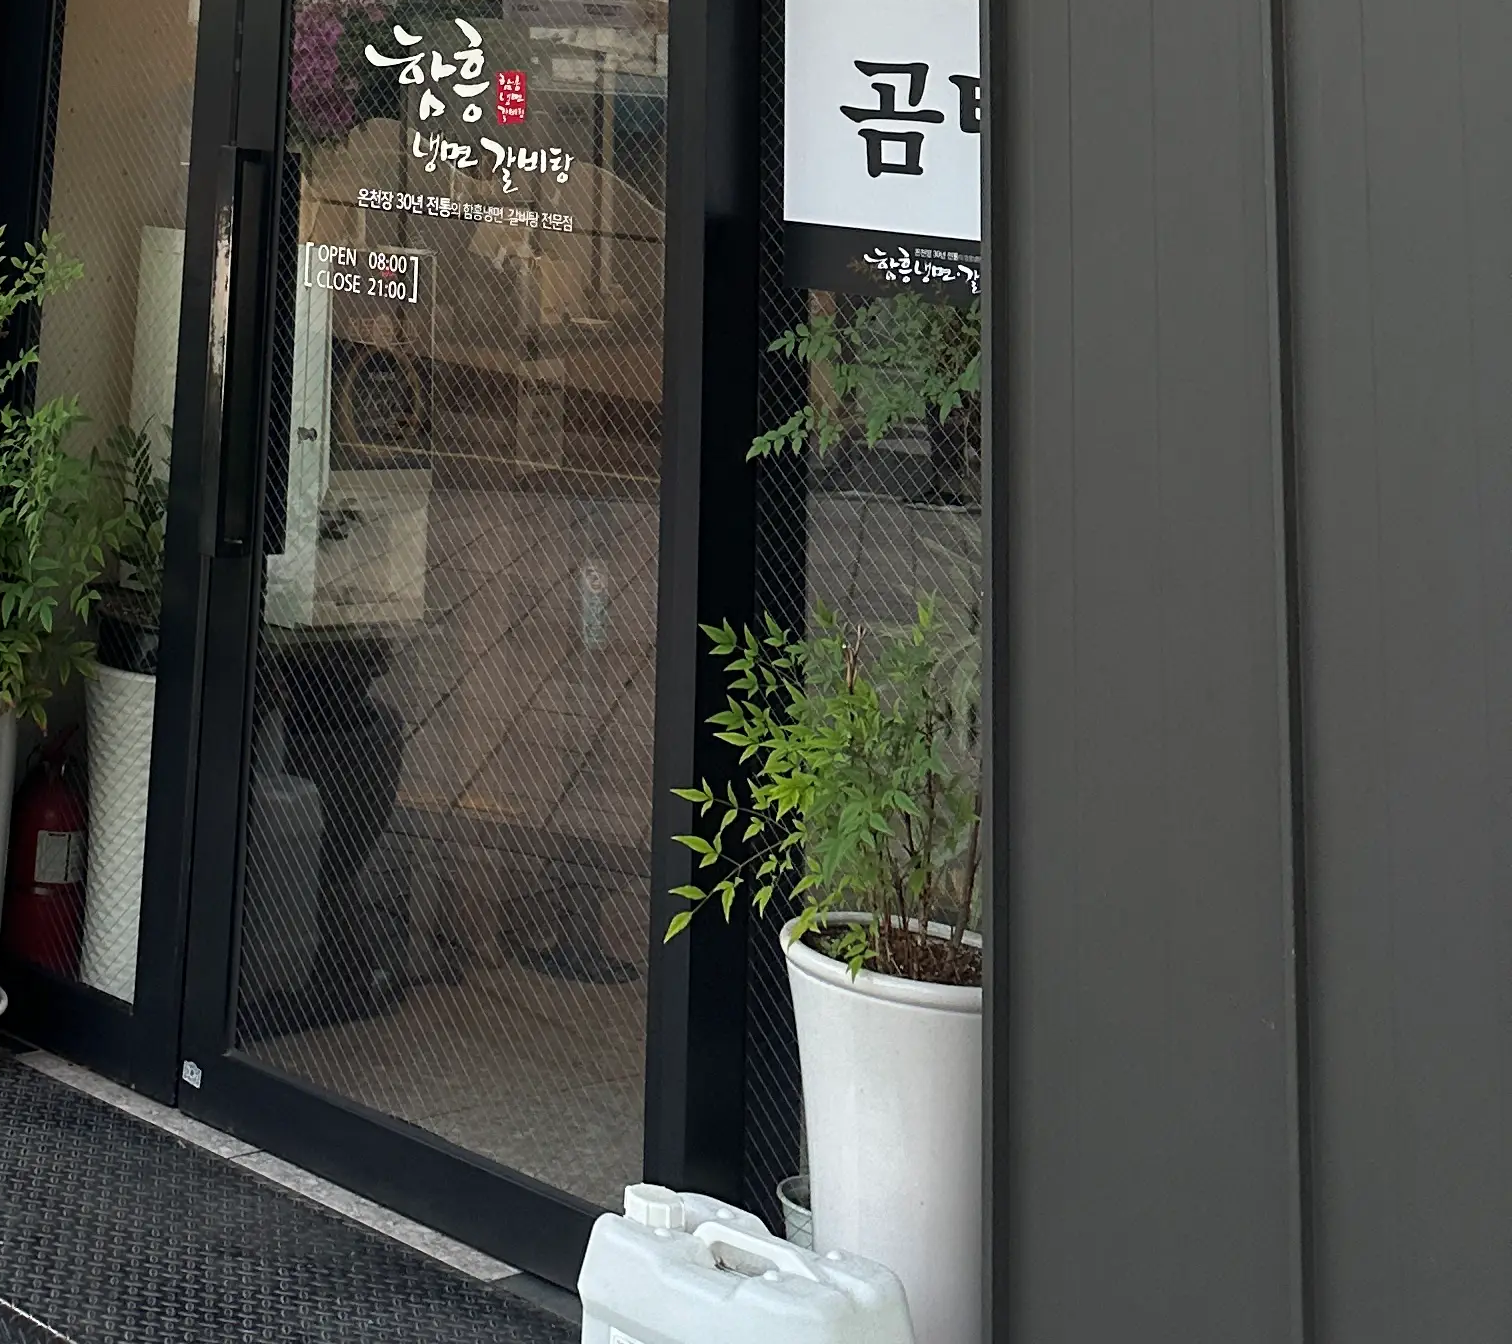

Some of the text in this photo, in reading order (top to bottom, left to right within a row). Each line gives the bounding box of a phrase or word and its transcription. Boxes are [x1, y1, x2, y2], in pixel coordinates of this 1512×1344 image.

[364, 17, 490, 123] 함흥
[412, 130, 575, 194] 냉면 갈비탕
[357, 188, 394, 210] 온천장
[396, 192, 424, 214] 30년
[426, 196, 462, 221] 전통의
[508, 208, 539, 228] 갈비탕
[541, 212, 573, 233] 전문점
[317, 244, 408, 275] OPEN 08:00
[316, 269, 407, 301] CLOSE 21:00
